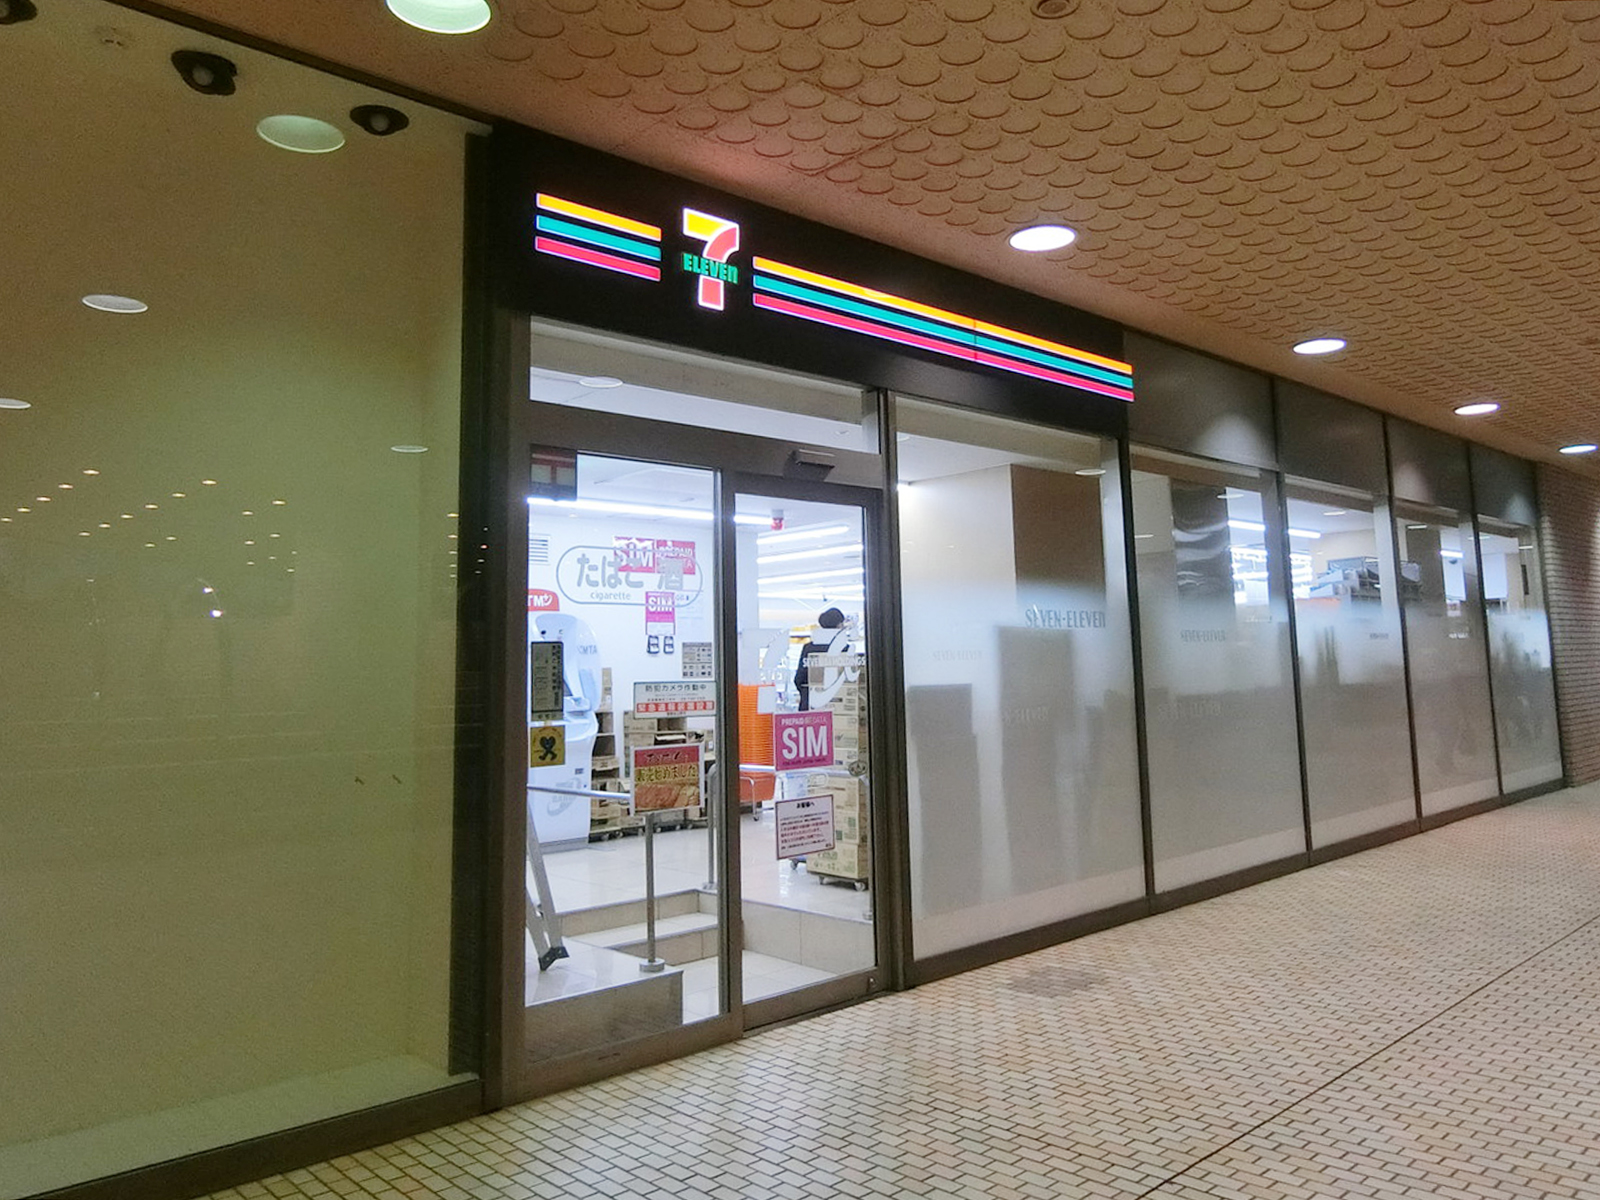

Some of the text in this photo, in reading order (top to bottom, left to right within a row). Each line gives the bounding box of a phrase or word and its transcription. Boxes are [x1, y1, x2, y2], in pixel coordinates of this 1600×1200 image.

[683, 208, 740, 311] 7
[576, 552, 644, 589] たばこ
[590, 592, 632, 602] cigarette
[648, 596, 673, 612] SIM
[782, 725, 828, 760] SIM
